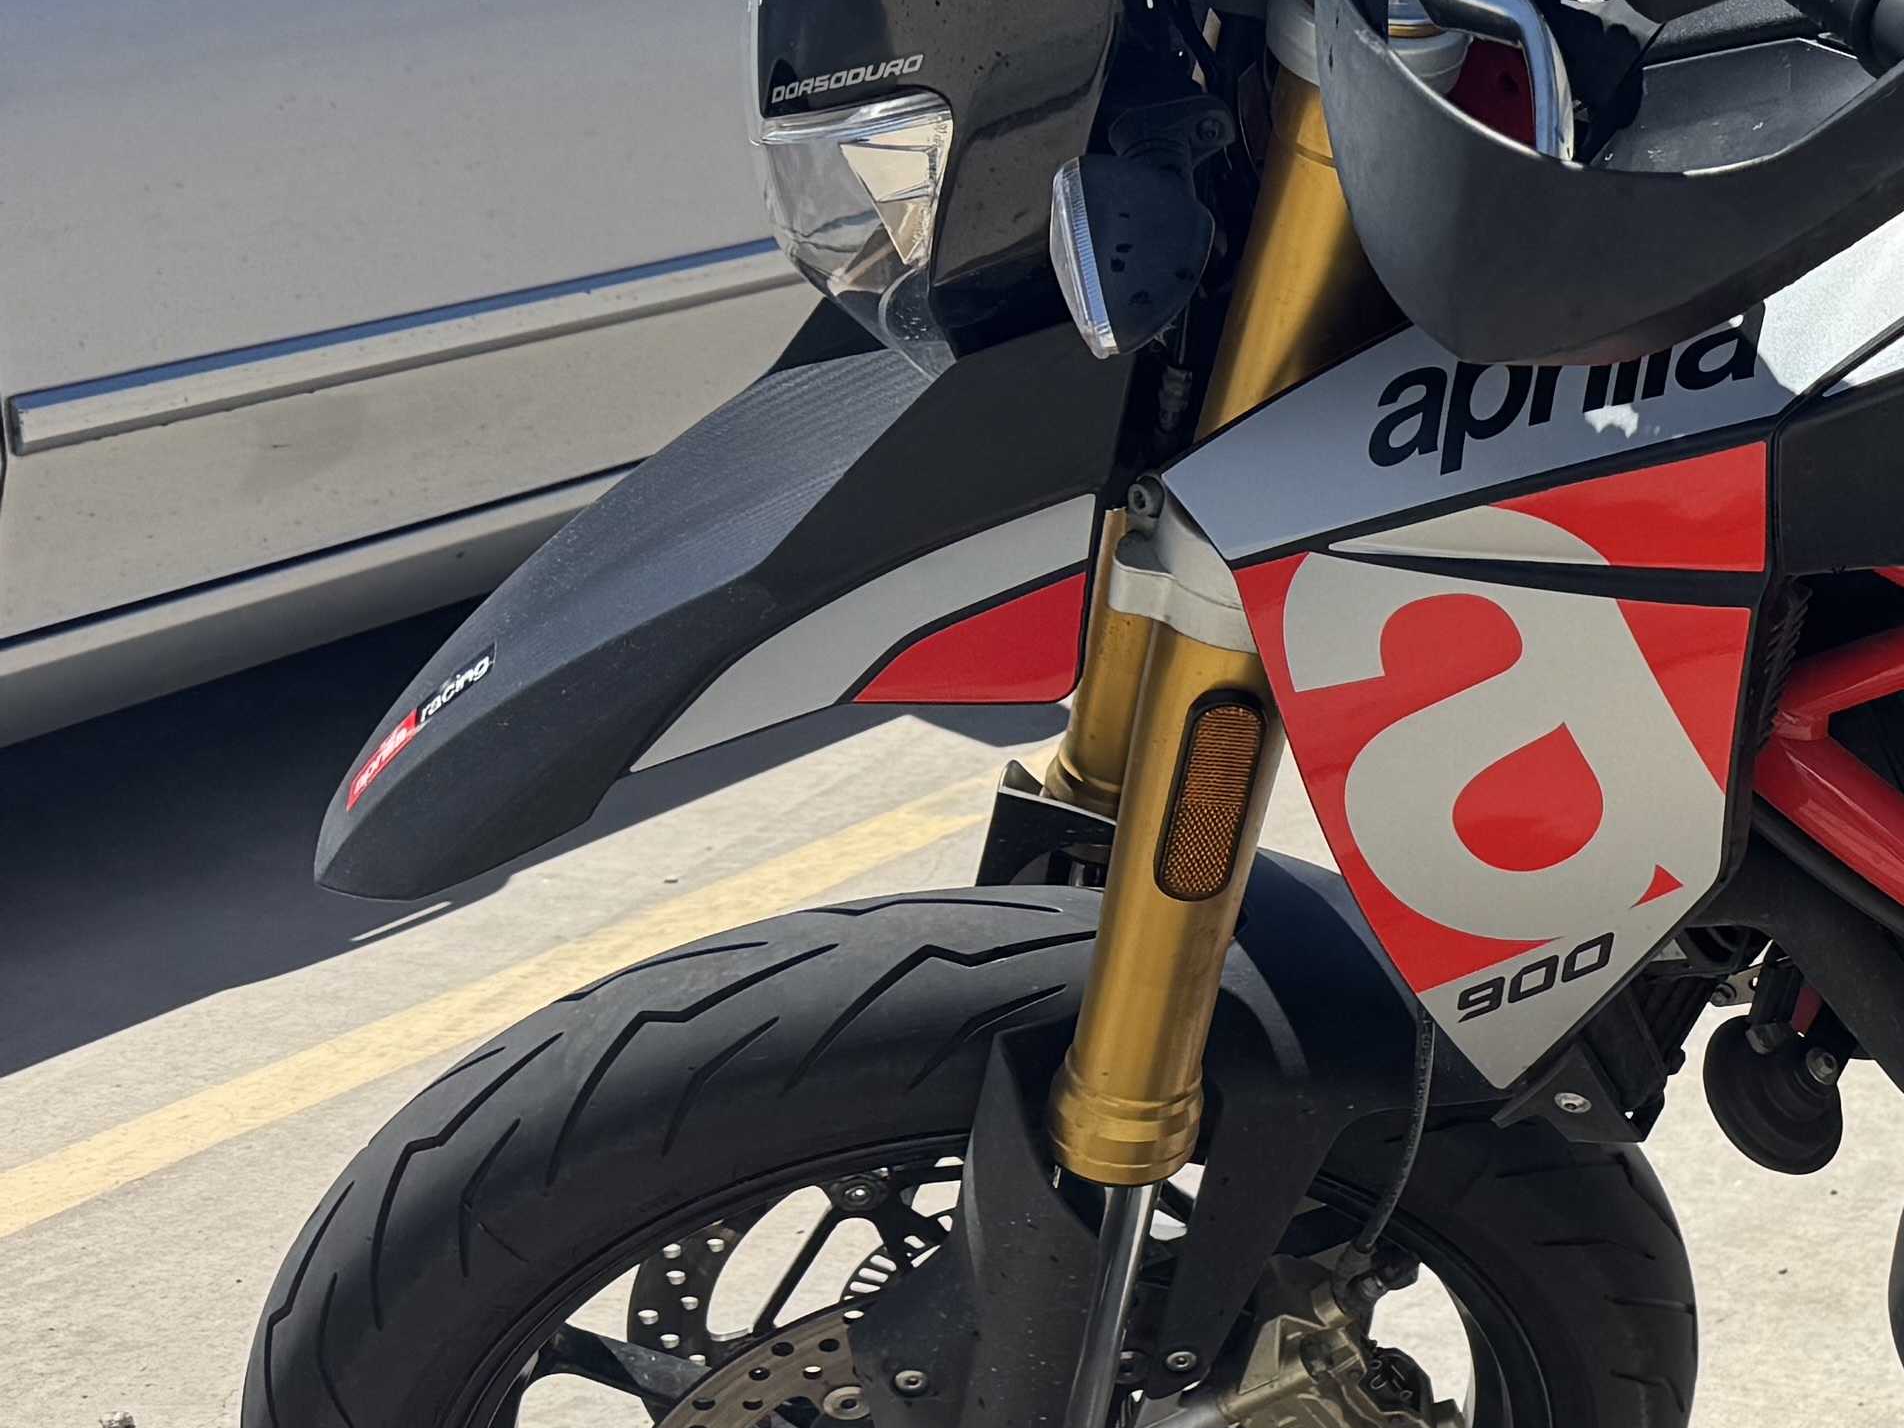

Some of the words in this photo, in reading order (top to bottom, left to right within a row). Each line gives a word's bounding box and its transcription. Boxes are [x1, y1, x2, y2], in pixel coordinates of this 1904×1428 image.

[771, 54, 924, 104] DORSODURO
[419, 655, 491, 723] racing
[1456, 931, 1615, 1023] 900
